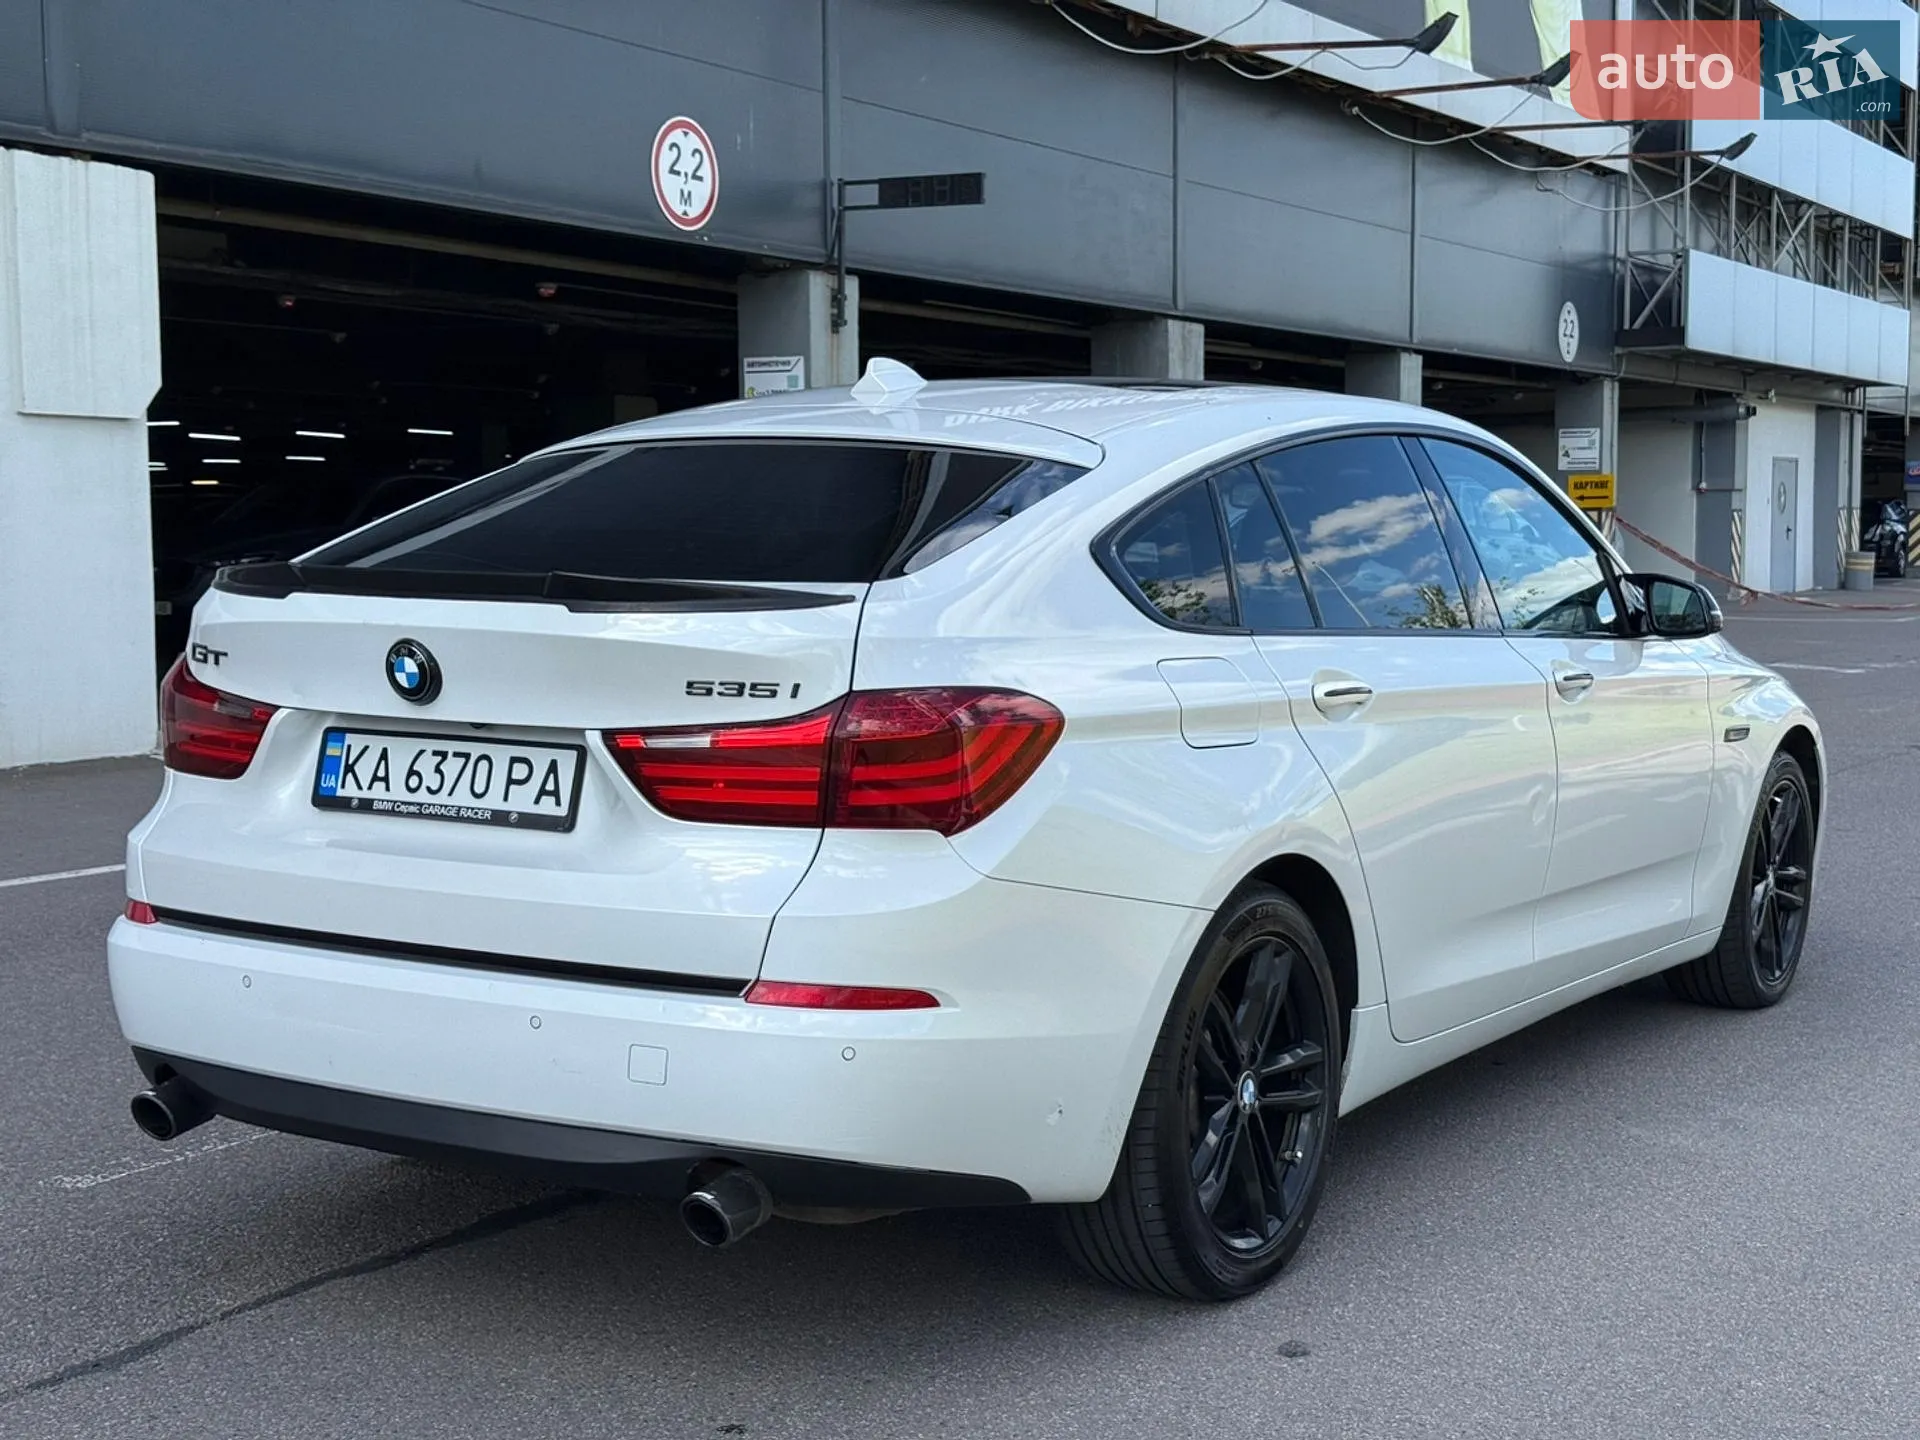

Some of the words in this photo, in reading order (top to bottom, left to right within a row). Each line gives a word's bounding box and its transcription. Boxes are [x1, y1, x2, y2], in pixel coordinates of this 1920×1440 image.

[668, 142, 704, 184] 2,2
[1573, 480, 1609, 490] КАРТИНГ
[192, 642, 228, 666] GT
[320, 772, 337, 790] UA
[340, 743, 391, 792] KA
[404, 749, 494, 800] 6370
[502, 755, 563, 808] PA
[372, 799, 393, 811] BMW
[421, 804, 459, 818] GARAGE
[459, 808, 493, 821] RACER
